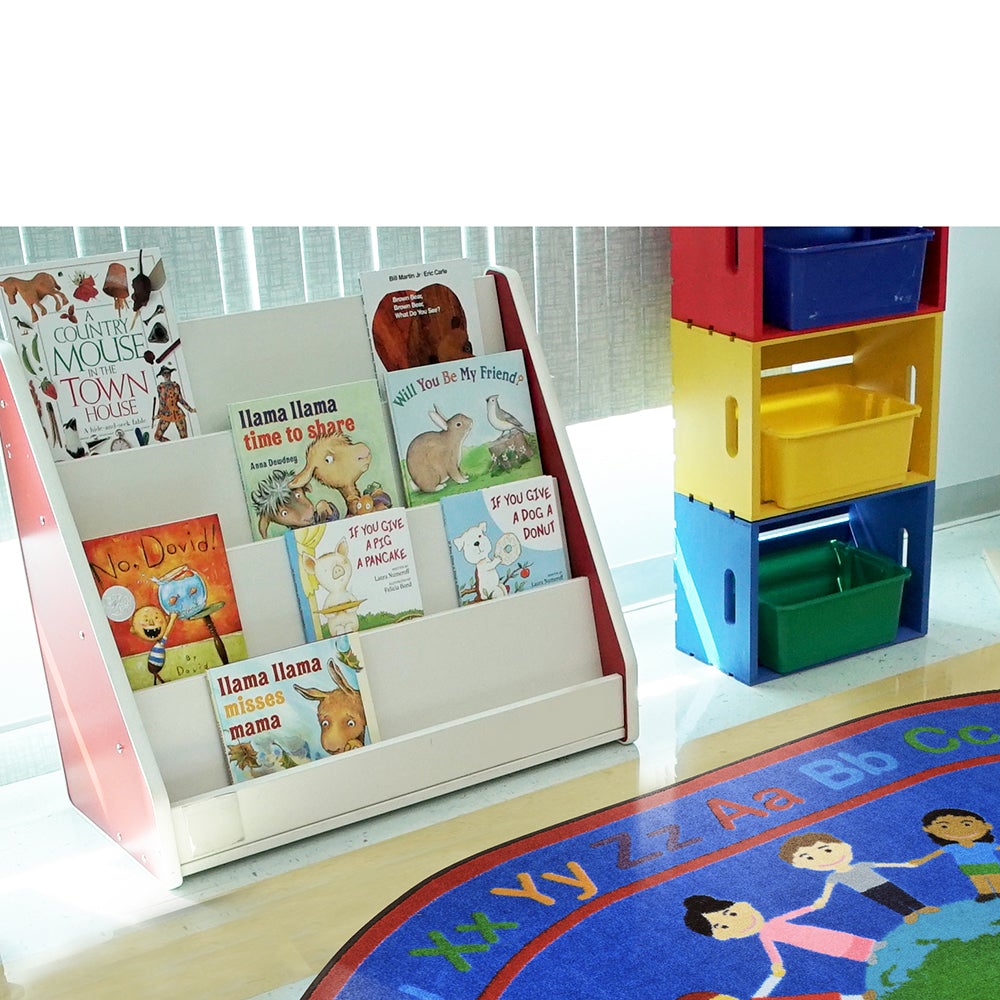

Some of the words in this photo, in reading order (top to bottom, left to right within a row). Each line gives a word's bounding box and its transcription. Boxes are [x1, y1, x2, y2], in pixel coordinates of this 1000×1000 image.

[85, 310, 94, 321] A
[395, 311, 409, 319] What
[428, 306, 440, 314] See?
[54, 318, 129, 343] COUNTRY
[53, 333, 145, 376] MOUSE
[88, 368, 98, 377] IN
[100, 365, 117, 375] THE
[60, 371, 149, 407] TOWN
[393, 383, 418, 407] Will
[416, 377, 440, 392] You
[442, 370, 457, 385] Be
[459, 367, 477, 383] My
[480, 366, 524, 386] Friend?
[85, 399, 138, 422] HOUSE
[238, 407, 288, 429] llama
[289, 399, 338, 419] llama
[243, 430, 282, 451] time
[285, 426, 303, 443] to
[307, 417, 355, 439] share
[250, 462, 267, 470] Anna
[490, 496, 501, 510] IF
[504, 493, 523, 506] YOU
[526, 487, 552, 501] GIVE
[513, 512, 519, 524] A
[521, 507, 544, 521] DOG
[547, 504, 553, 517] A
[349, 525, 359, 539] IF
[361, 521, 379, 536] YOU
[381, 518, 404, 532] GIVE
[523, 520, 555, 540] DONUT
[366, 540, 372, 551] A
[374, 535, 392, 549] PIG
[357, 558, 363, 569] A
[365, 549, 407, 567] PANCAKE
[217, 671, 270, 696] llama
[272, 657, 322, 682] llama
[224, 690, 285, 719] misses
[229, 714, 282, 740] mama
[903, 724, 1000, 754] Cc
[799, 748, 899, 791] Bb
[705, 786, 805, 830] Aa
[590, 824, 703, 870] Zz
[490, 860, 599, 906] Yy
[408, 911, 519, 973] Xx
